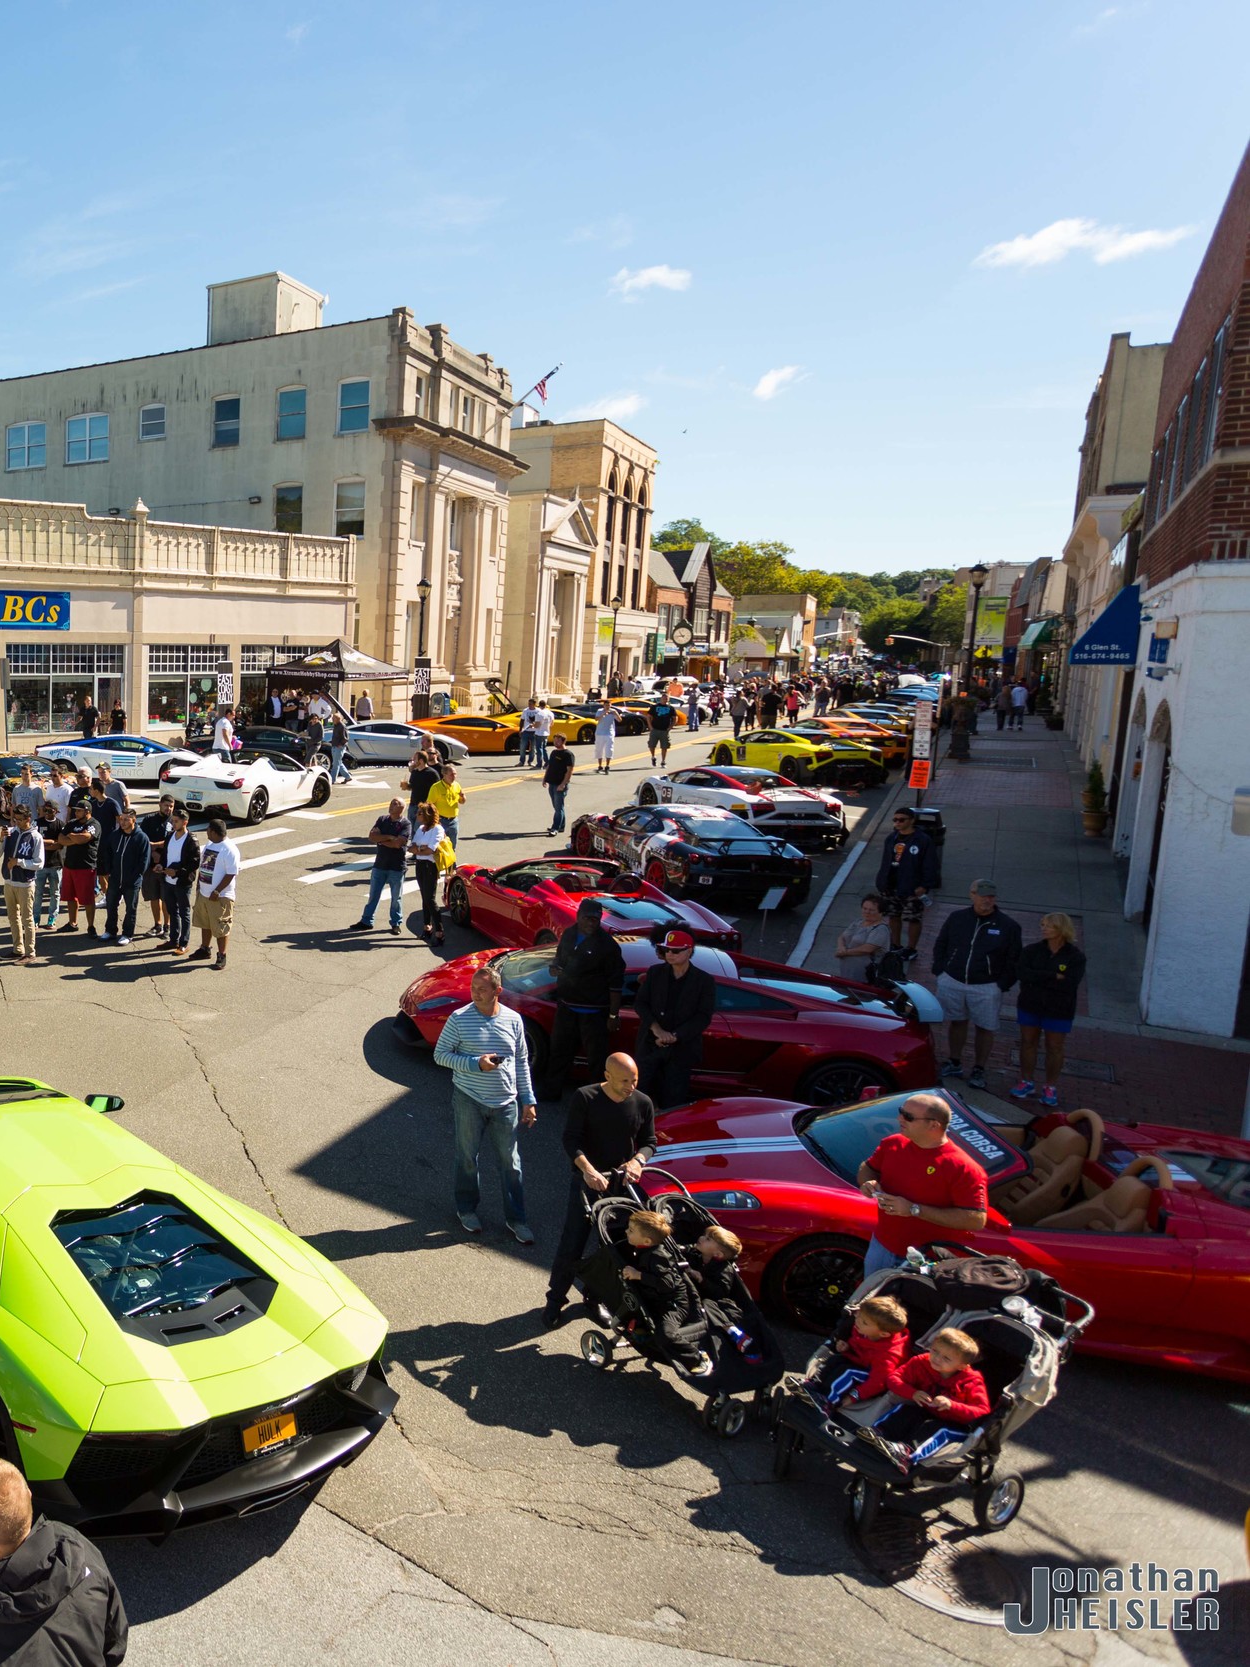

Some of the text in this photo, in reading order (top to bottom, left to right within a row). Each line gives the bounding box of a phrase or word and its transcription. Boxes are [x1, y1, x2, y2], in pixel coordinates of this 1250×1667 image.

[414, 668, 430, 678] EAST
[218, 674, 233, 685] EAST
[218, 684, 233, 694] COAST
[218, 693, 234, 704] RALLY
[661, 787, 672, 798] 03
[18, 841, 32, 856] NY
[958, 1129, 1006, 1160] CORSA
[257, 1418, 283, 1445] HULK
